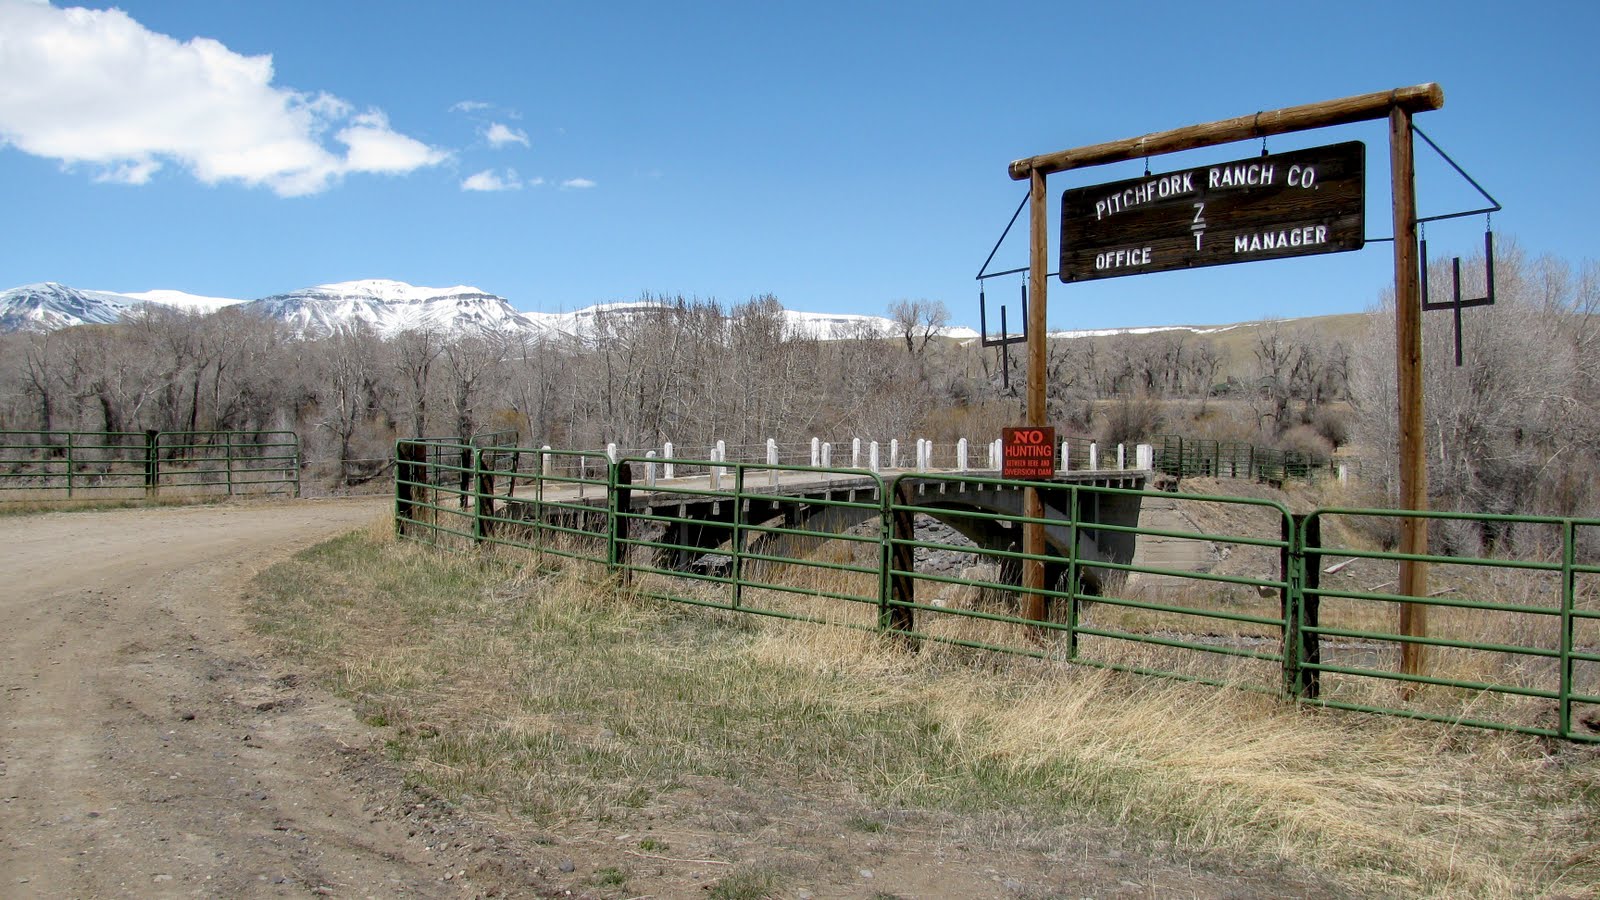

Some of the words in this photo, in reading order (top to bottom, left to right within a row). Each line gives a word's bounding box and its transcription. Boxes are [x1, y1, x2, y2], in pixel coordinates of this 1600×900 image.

[1096, 172, 1193, 220] PITCHFORK
[1209, 164, 1274, 188] RANCH
[1287, 165, 1319, 190] CO.
[1193, 203, 1205, 223] Z
[1095, 248, 1151, 270] OFFICE
[1234, 226, 1327, 253] MANAGER
[1193, 231, 1204, 251] T
[1013, 430, 1043, 444] NO
[1005, 445, 1051, 457] HUNTING
[1004, 468, 1036, 476] DIVERSION
[1038, 468, 1051, 476] DAM
